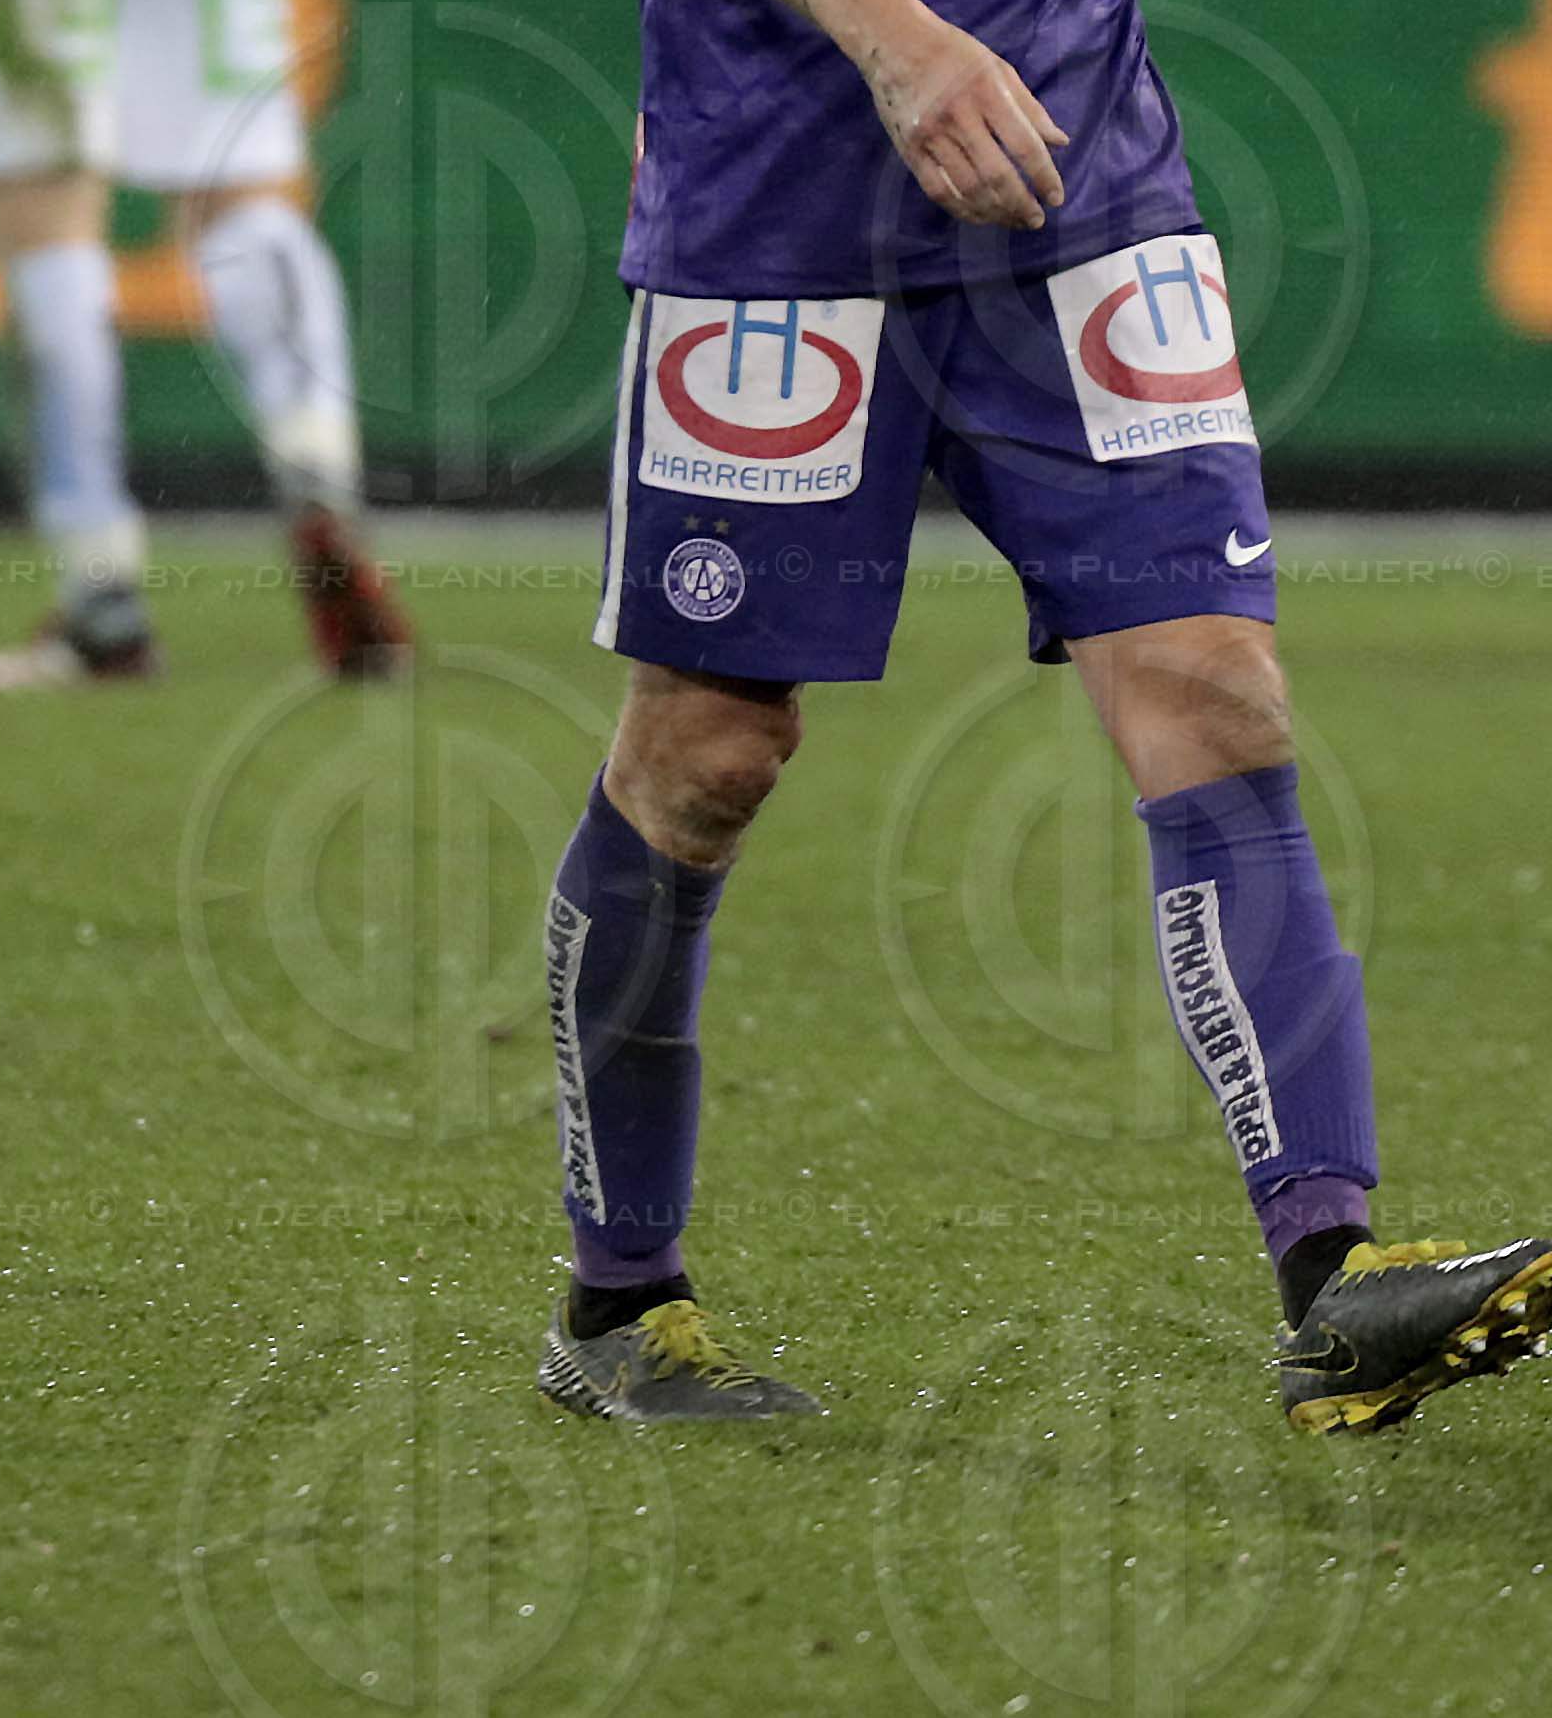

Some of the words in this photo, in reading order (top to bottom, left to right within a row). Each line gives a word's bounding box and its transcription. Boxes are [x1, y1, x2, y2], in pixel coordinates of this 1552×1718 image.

[650, 449, 852, 494] HARREITHER
[1164, 889, 1243, 1063] BEYSCHLAG
[1219, 1052, 1253, 1087] &
[1226, 1083, 1270, 1163] OPEL
